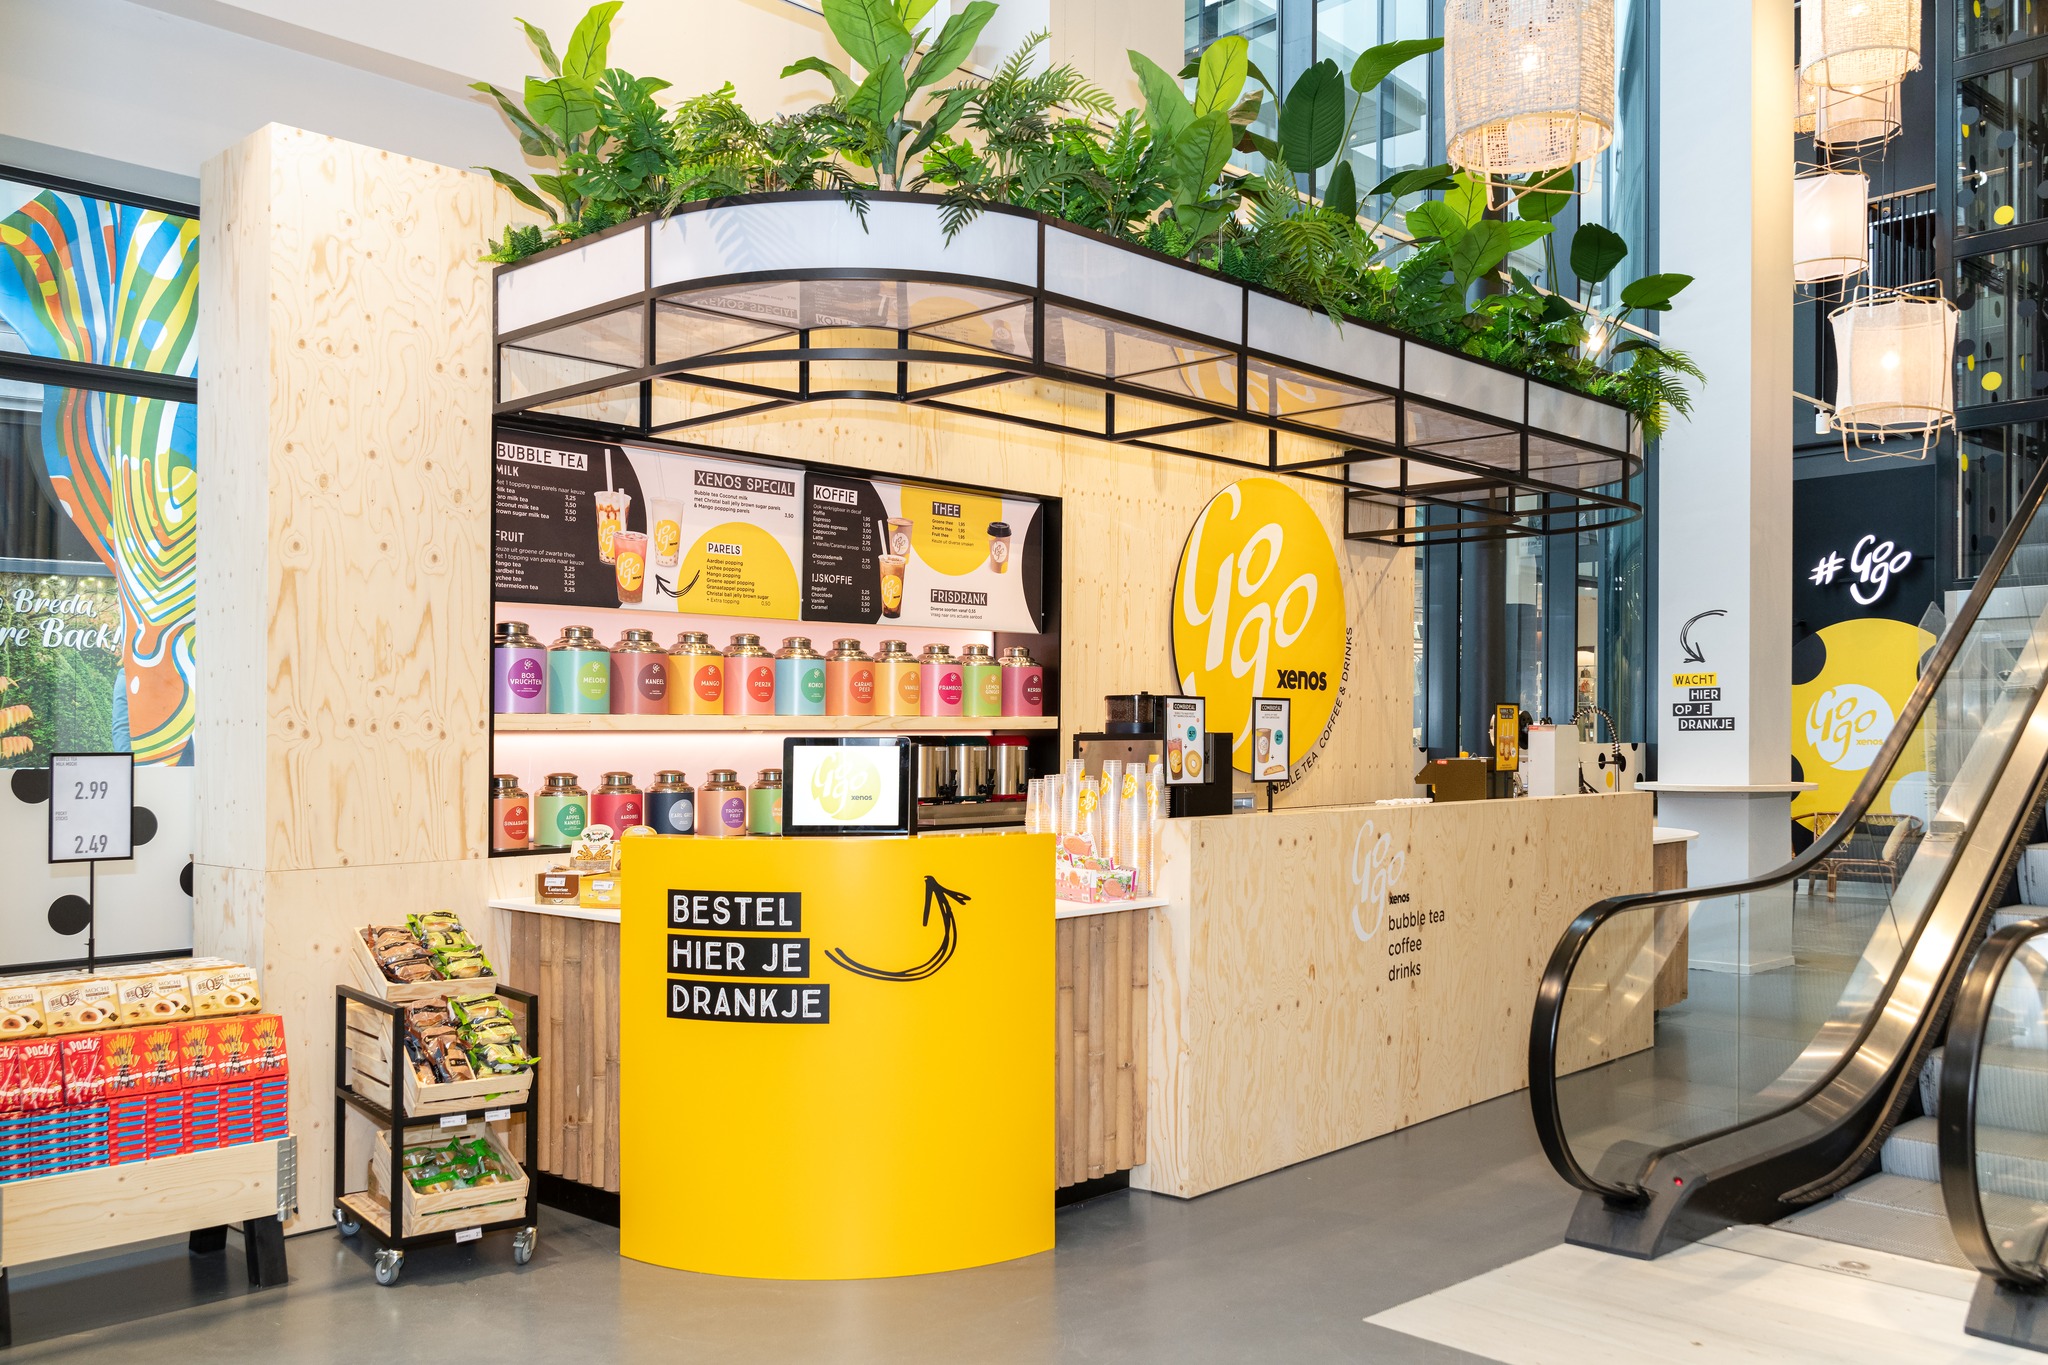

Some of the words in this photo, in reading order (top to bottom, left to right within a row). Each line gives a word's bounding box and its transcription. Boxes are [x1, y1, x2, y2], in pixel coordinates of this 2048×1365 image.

[497, 443, 552, 464] BUBBLE
[559, 452, 584, 469] TEA
[496, 463, 519, 477] MILK
[509, 481, 530, 489] topping
[697, 471, 742, 489] XENOS
[746, 477, 793, 496] SPECIAL
[815, 486, 855, 503] KOFFIE
[698, 503, 714, 511] Mango
[933, 502, 960, 517] THEE
[508, 553, 528, 562] topping
[708, 543, 741, 555] PARELS
[811, 573, 853, 585] IJSKOFFIE
[1850, 534, 1912, 605] Gogo
[13, 588, 97, 618] Breda,
[932, 590, 986, 605] FRISDRANK
[39, 617, 121, 652] Back!
[1342, 627, 1353, 682] DRINKS
[510, 678, 543, 686] VRUCHTEN
[1277, 669, 1327, 691] xenos
[1675, 674, 1714, 685] WACHT
[1339, 686, 1347, 696] &
[1691, 689, 1719, 700] HIER
[1674, 704, 1692, 715] OP
[1696, 704, 1710, 714] JE
[1319, 697, 1343, 748] COFFEE
[1680, 719, 1733, 729] DRANKJE
[1301, 751, 1318, 773] TEA
[74, 781, 108, 800] 2.99
[1267, 769, 1302, 796] UBBLE
[74, 834, 108, 854] 2.49
[1388, 892, 1410, 905] xenos
[672, 894, 792, 927] BESTEL
[1388, 910, 1426, 931] bubble
[1429, 909, 1445, 924] tea
[672, 939, 745, 971] HIER
[762, 943, 802, 972] JE
[1388, 937, 1422, 957] coffee
[1388, 962, 1421, 982] drinks
[672, 984, 822, 1019] DRANKJE
